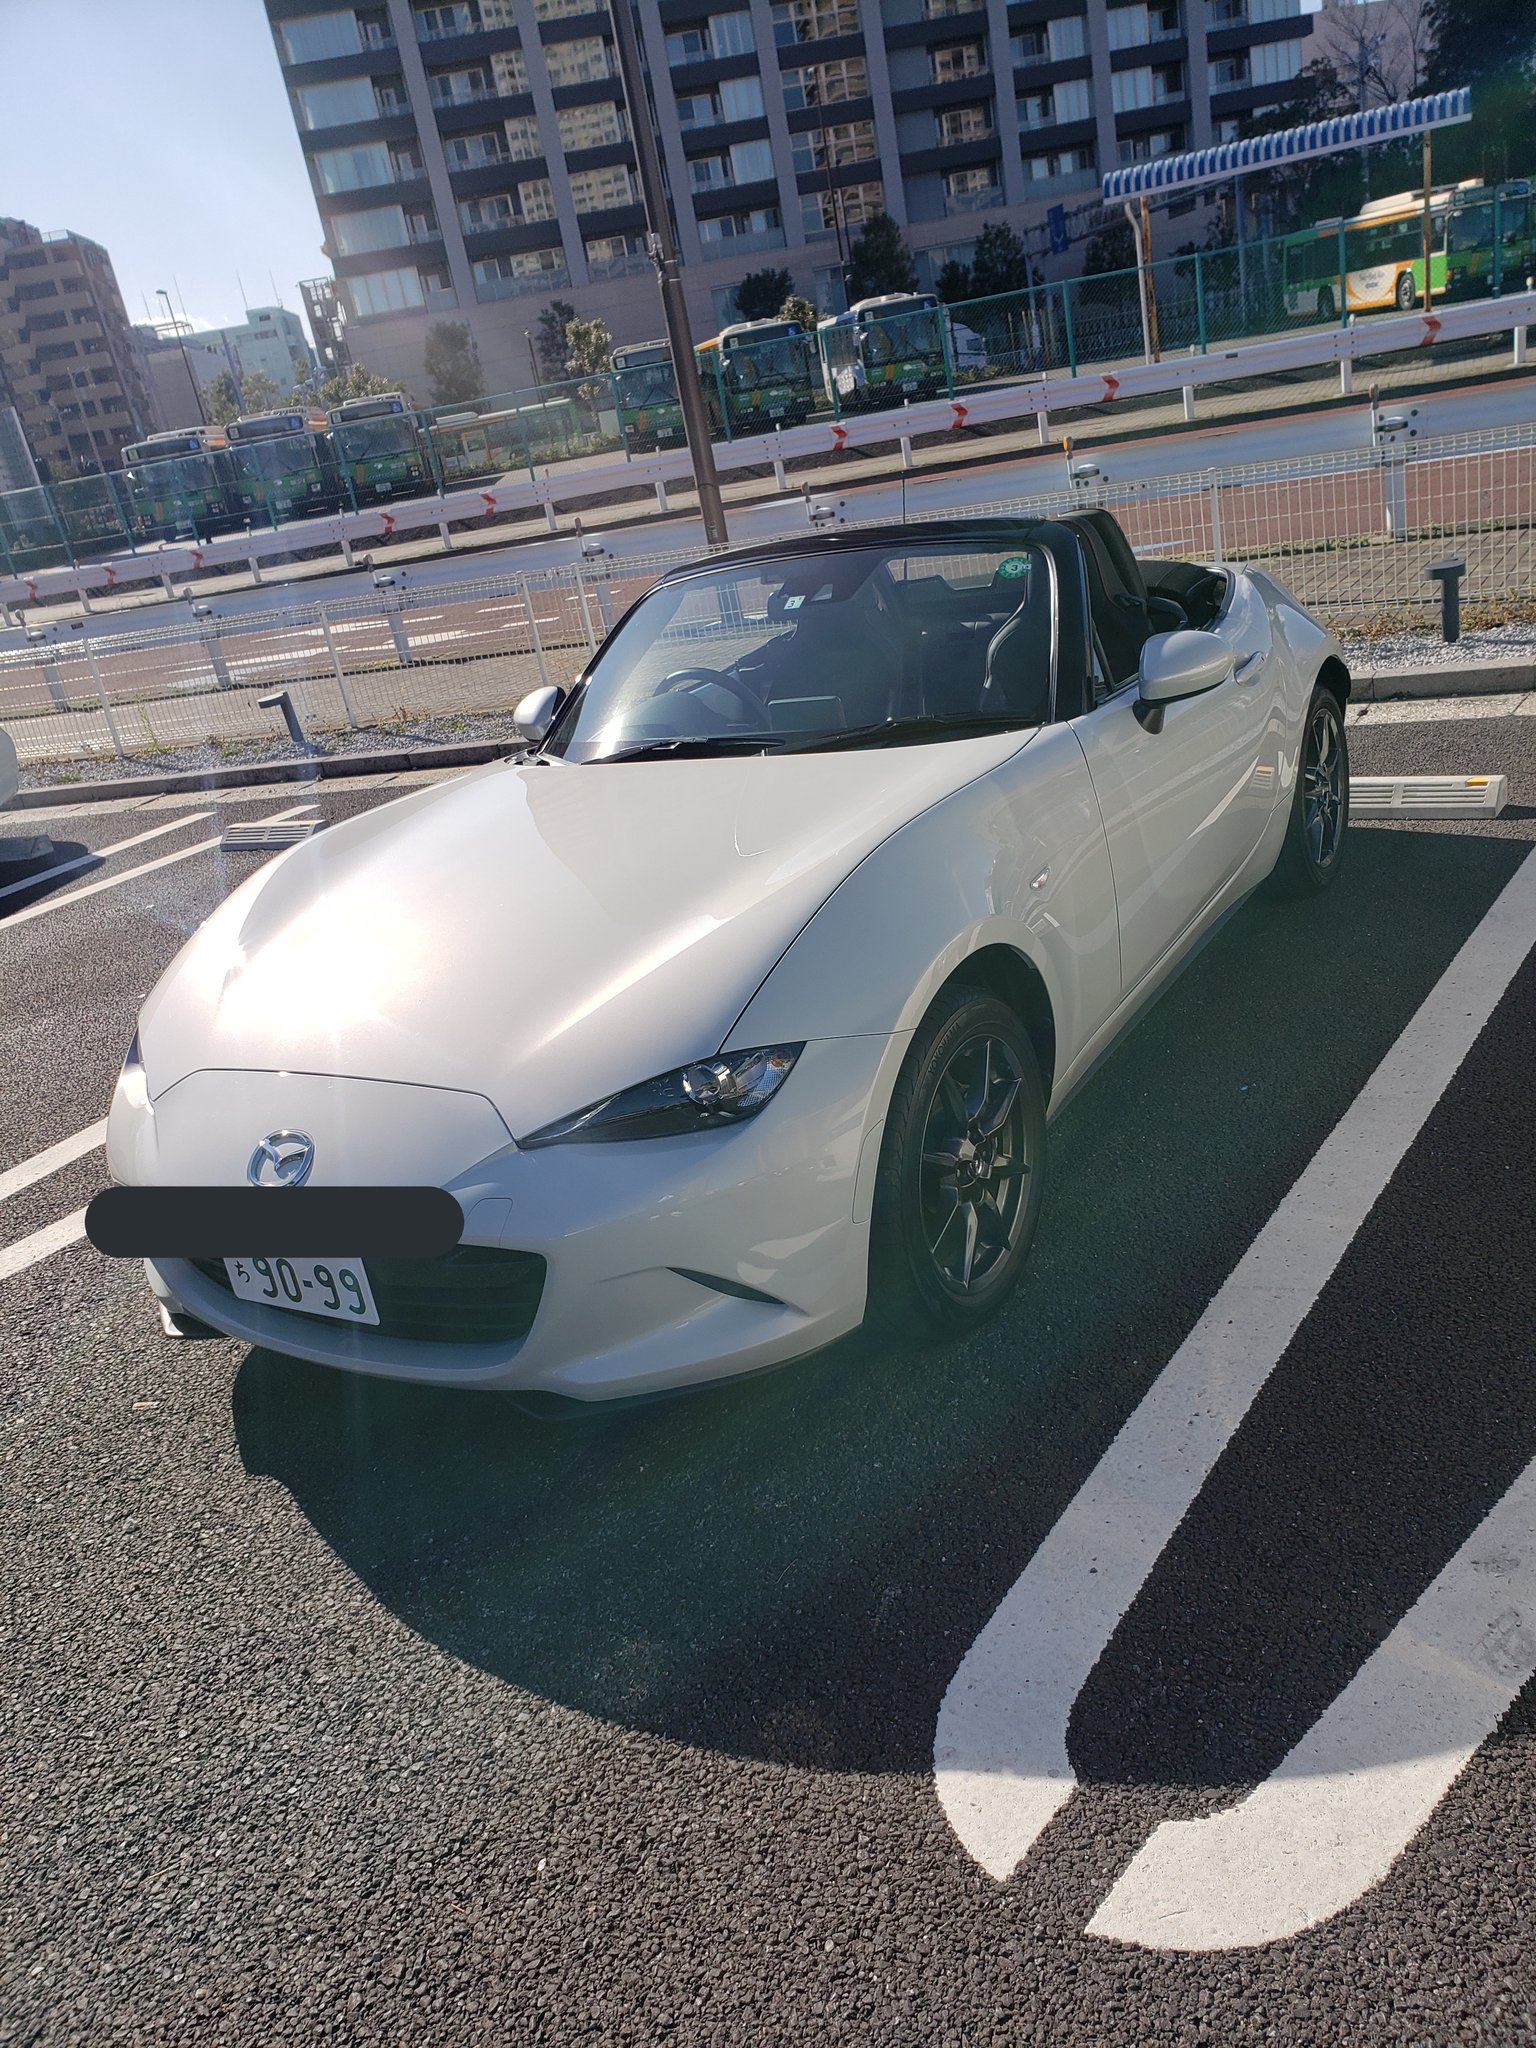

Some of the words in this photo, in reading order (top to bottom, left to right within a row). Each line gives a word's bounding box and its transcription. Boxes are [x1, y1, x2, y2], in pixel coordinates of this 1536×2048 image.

[927, 1022, 961, 1074] YOKOHAMA
[234, 1260, 251, 1283] ち
[252, 1258, 367, 1315] 90-99
